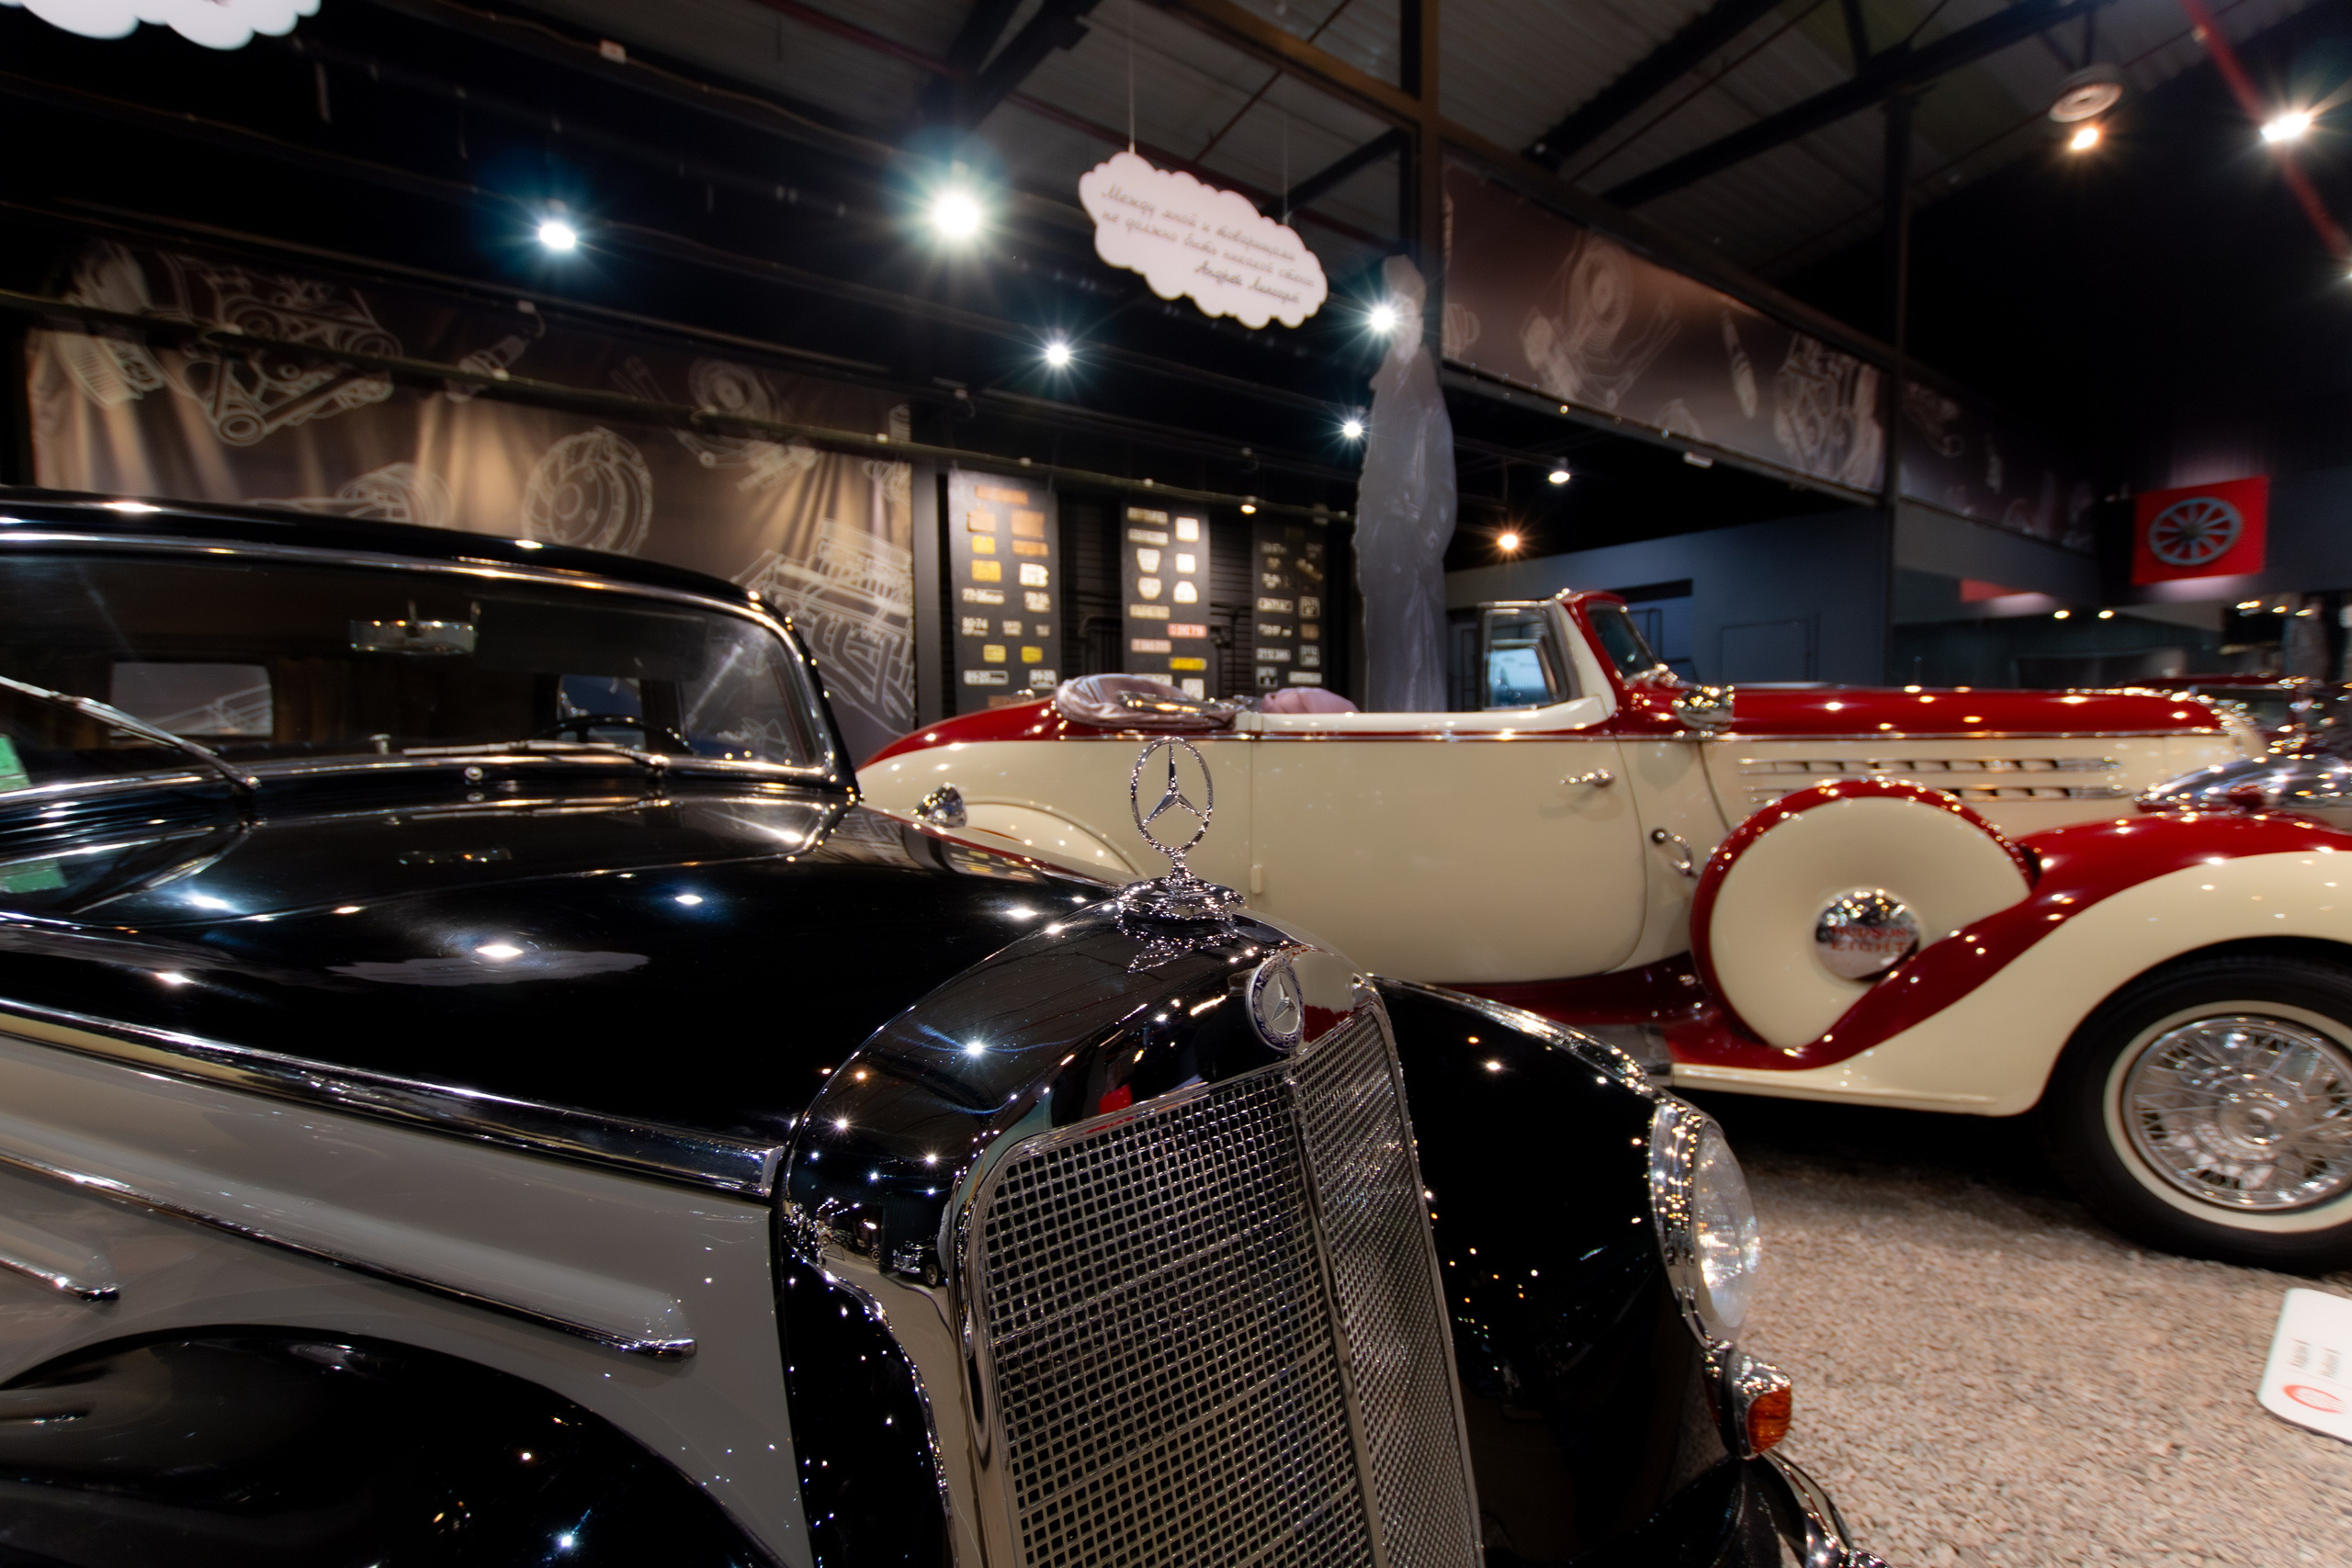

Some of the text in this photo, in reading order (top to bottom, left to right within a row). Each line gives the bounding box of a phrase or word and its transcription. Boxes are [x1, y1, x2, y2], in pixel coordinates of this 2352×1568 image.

[1102, 184, 1156, 218] Между
[1102, 210, 1120, 222] не
[1194, 260, 1242, 285] Андрей
